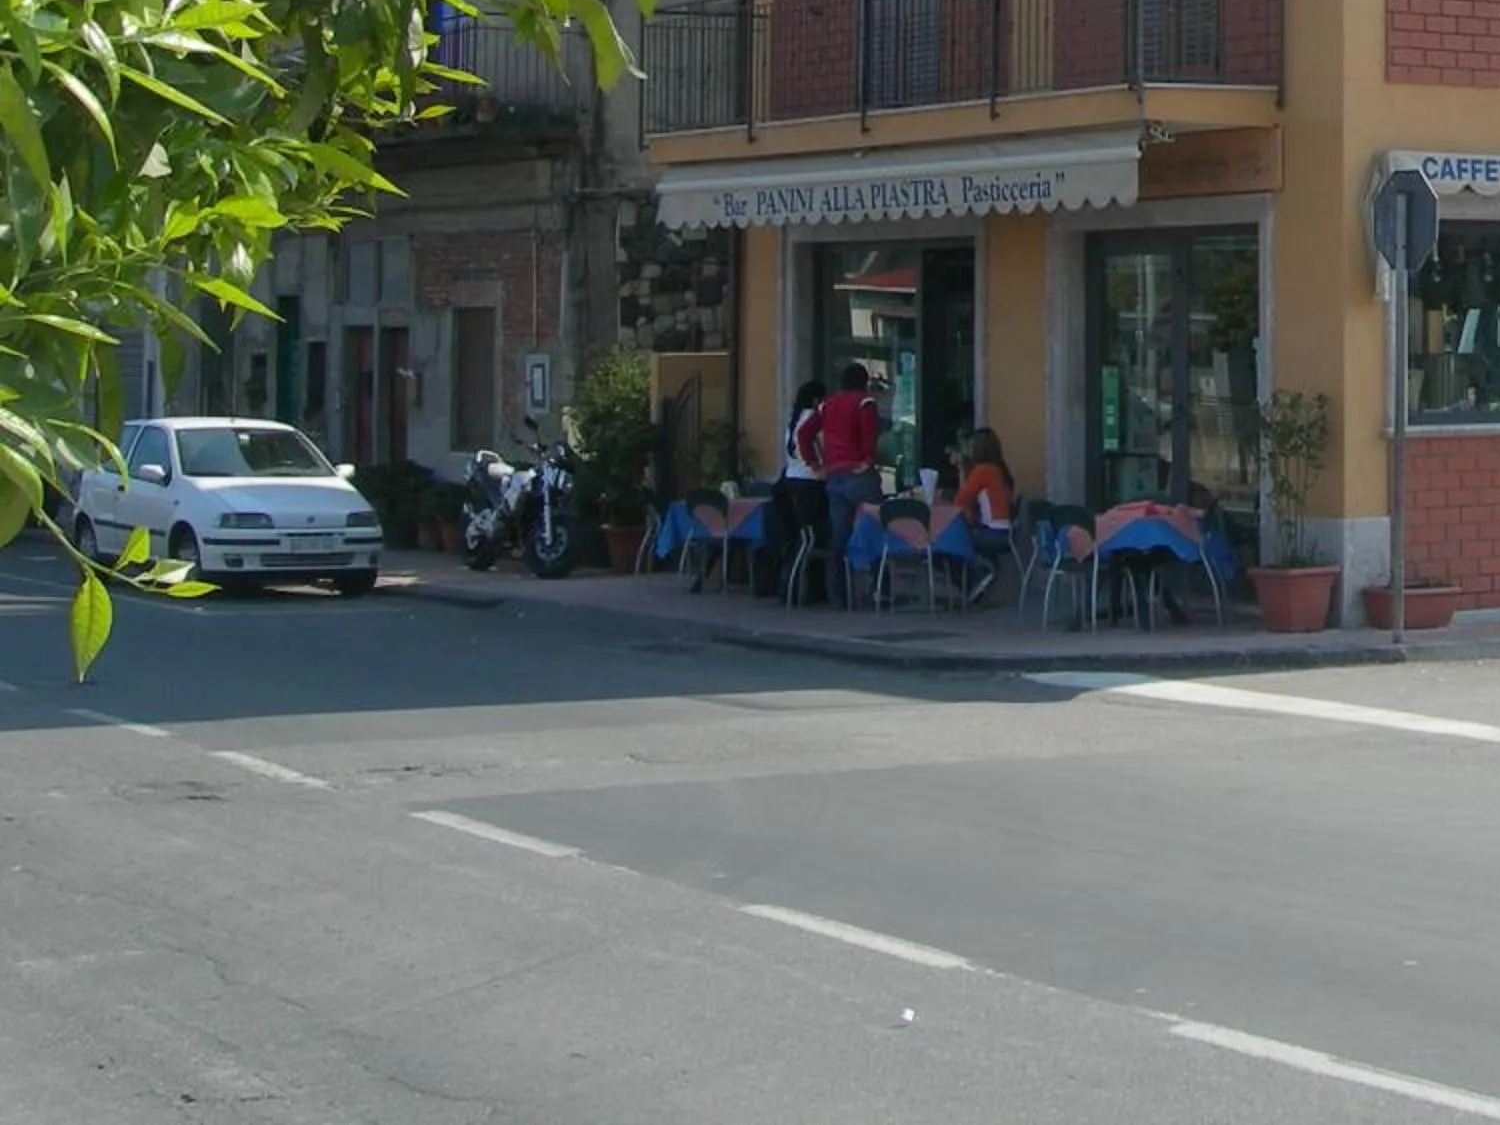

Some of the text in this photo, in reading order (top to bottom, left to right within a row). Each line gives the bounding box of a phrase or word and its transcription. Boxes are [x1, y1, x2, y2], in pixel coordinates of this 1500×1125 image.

[756, 186, 814, 215] PANINI
[820, 186, 866, 212] ALLA
[870, 179, 950, 210] PIASTRA
